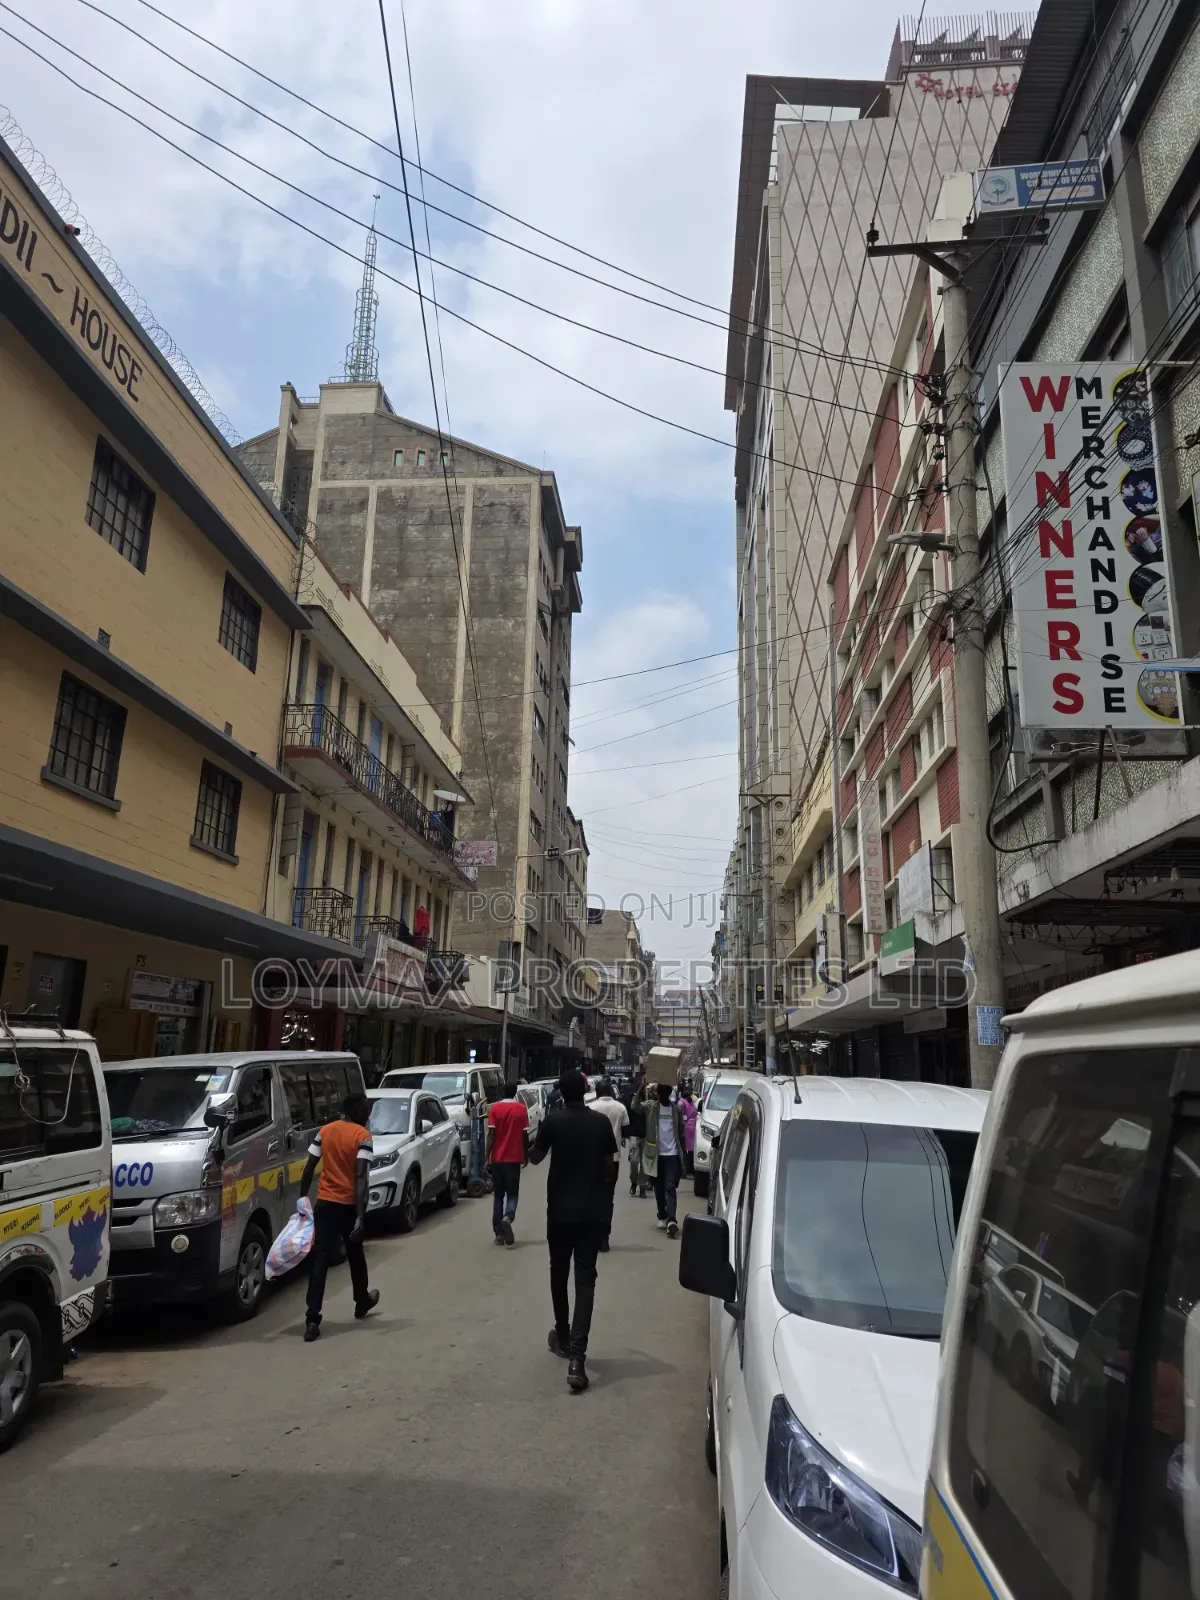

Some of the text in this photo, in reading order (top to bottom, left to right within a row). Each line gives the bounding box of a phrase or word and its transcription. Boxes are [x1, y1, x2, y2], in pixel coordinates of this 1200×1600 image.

[1060, 175, 1071, 184] OF
[70, 286, 143, 403] HOUSE
[1019, 375, 1085, 716] WINNERS
[1074, 376, 1127, 714] MERCHANDISE
[3, 1213, 40, 1235] NYERI KISUMU
[54, 1200, 73, 1221] ELDORET
